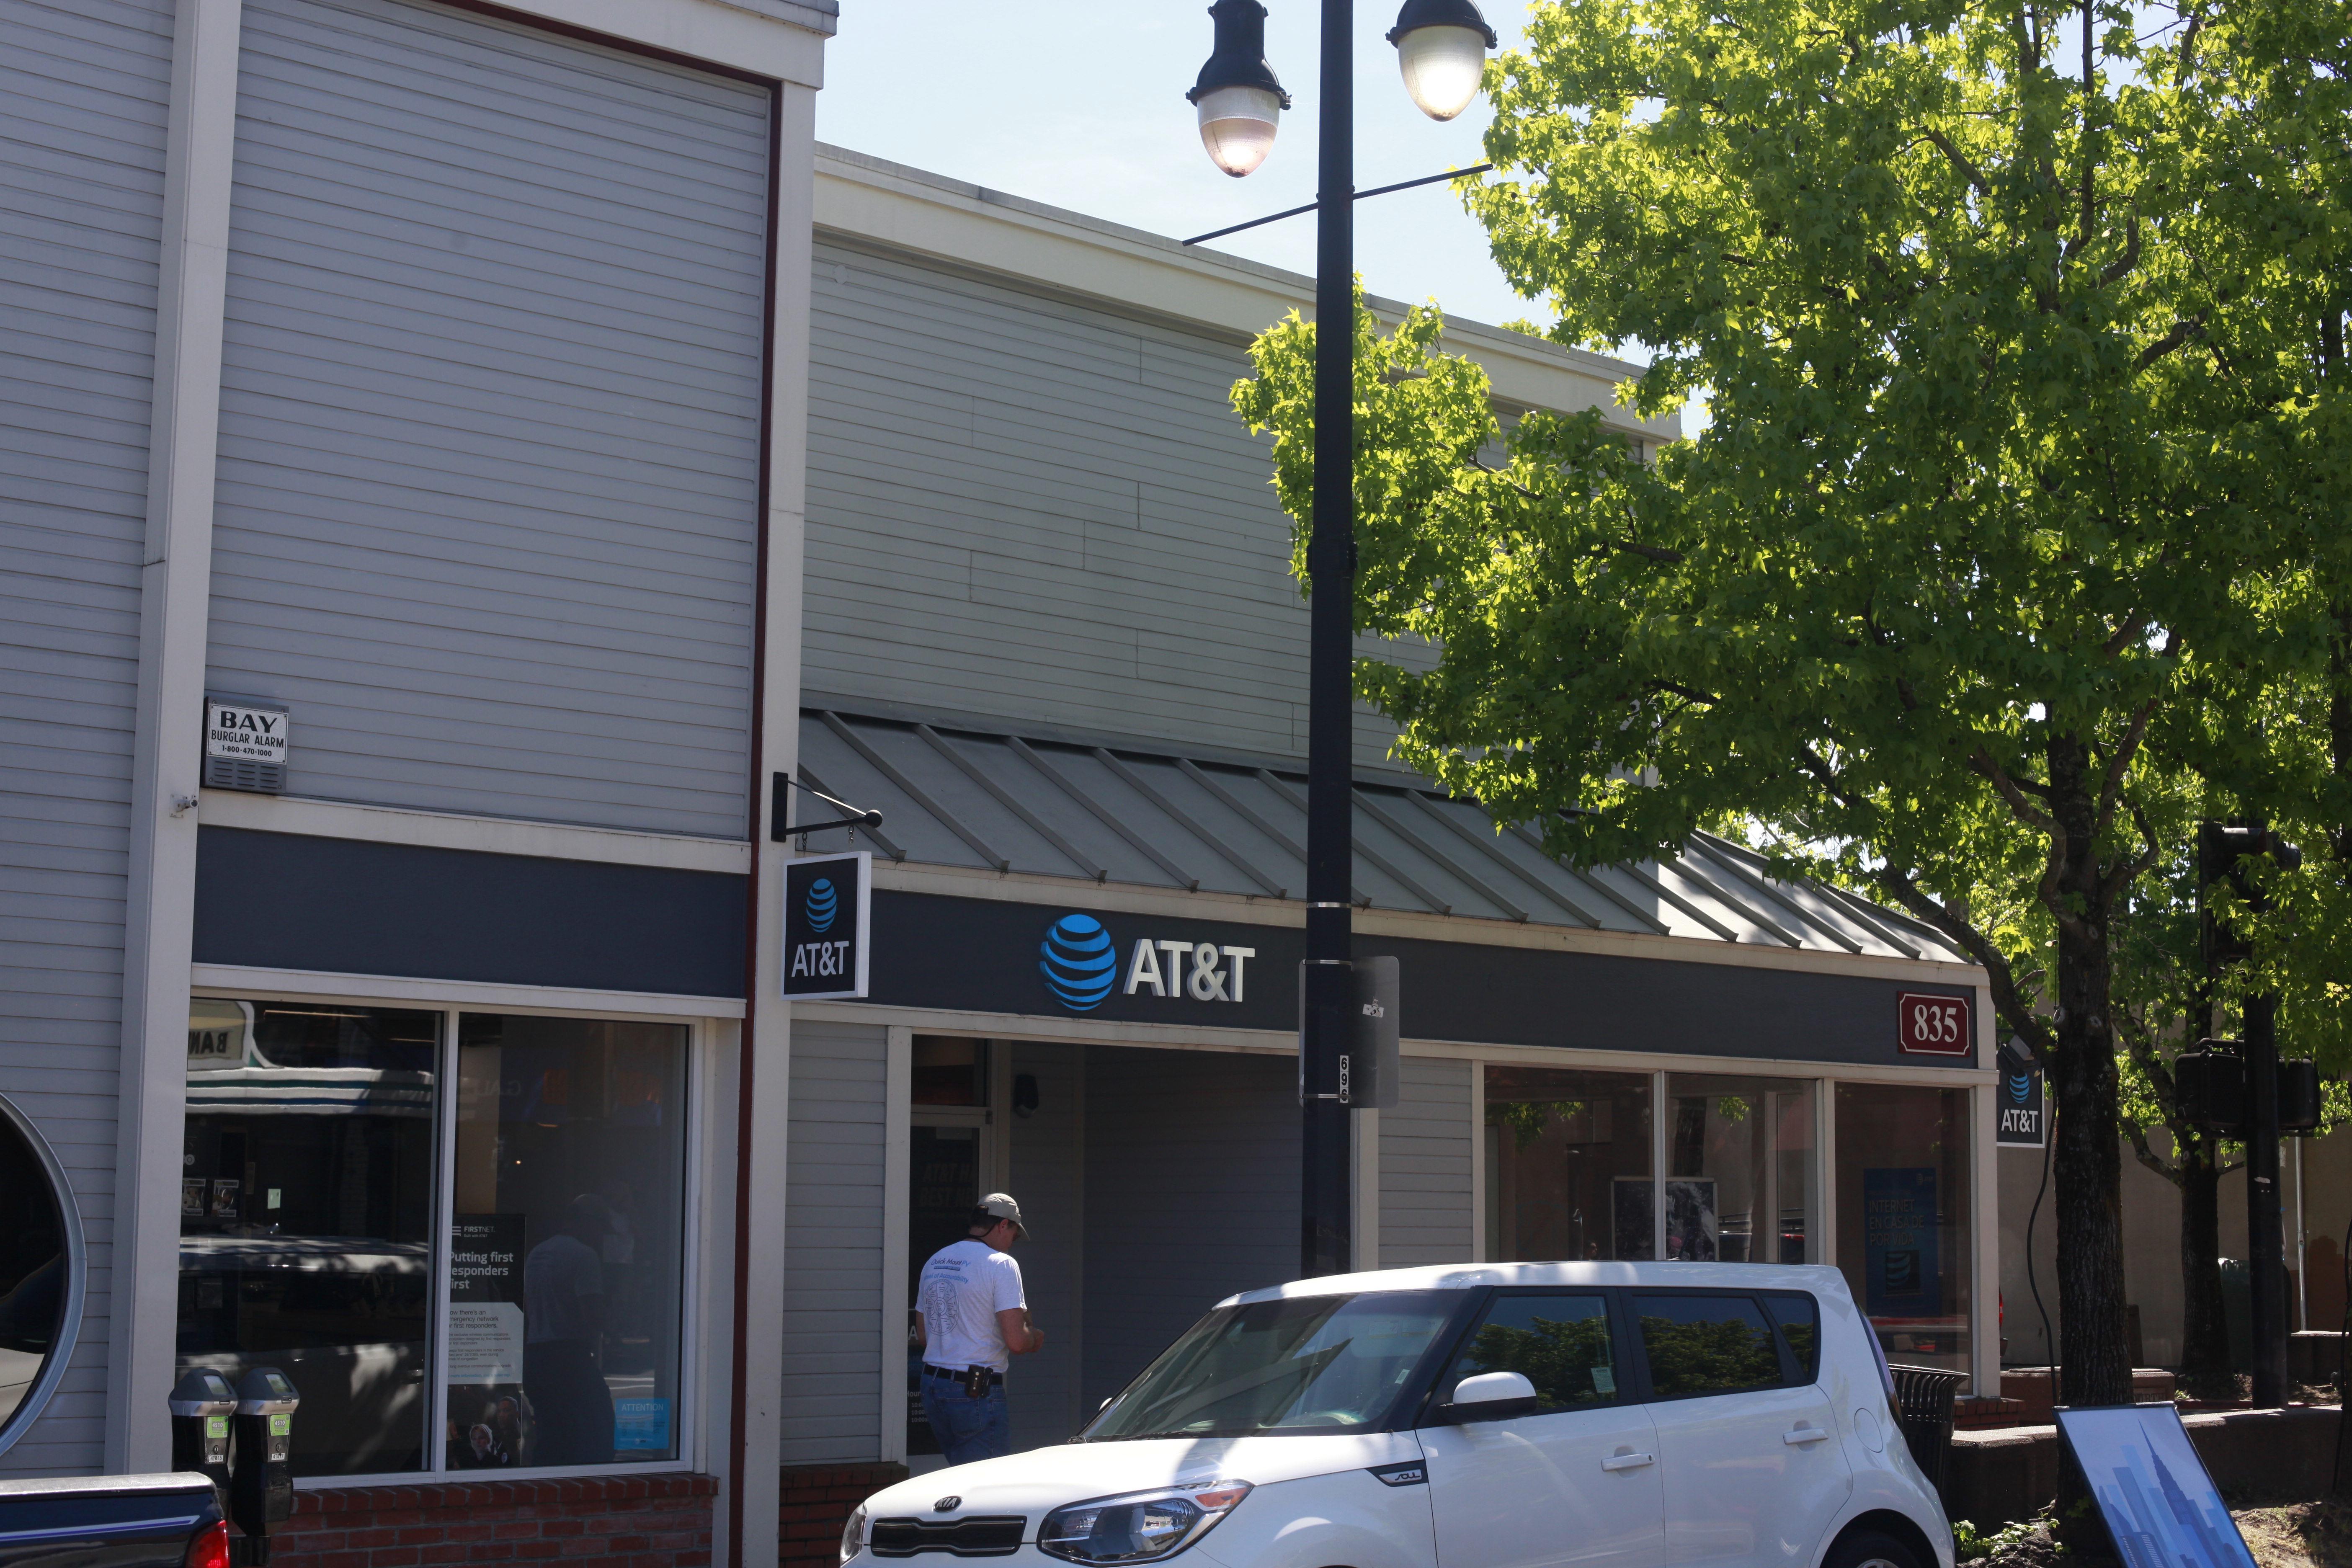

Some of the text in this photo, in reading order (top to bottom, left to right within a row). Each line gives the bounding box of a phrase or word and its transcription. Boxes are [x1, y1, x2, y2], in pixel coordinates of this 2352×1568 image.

[221, 711, 277, 733] BAY
[211, 730, 284, 748] BURGLAR ALARM
[222, 745, 272, 757] 1-800-470-1000
[791, 941, 849, 977] AT&T
[1123, 939, 1255, 1002] AT&T
[1914, 1004, 1957, 1042] 835
[2001, 1109, 2038, 1132] AT&T
[1869, 1199, 1915, 1213] INTERNET
[1870, 1215, 1925, 1230] EN CASA DE
[1870, 1232, 1914, 1246] POR VIDA
[490, 1251, 514, 1263] first
[451, 1265, 509, 1278] esponders
[451, 1278, 470, 1289] irst
[936, 1498, 957, 1508] KIA
